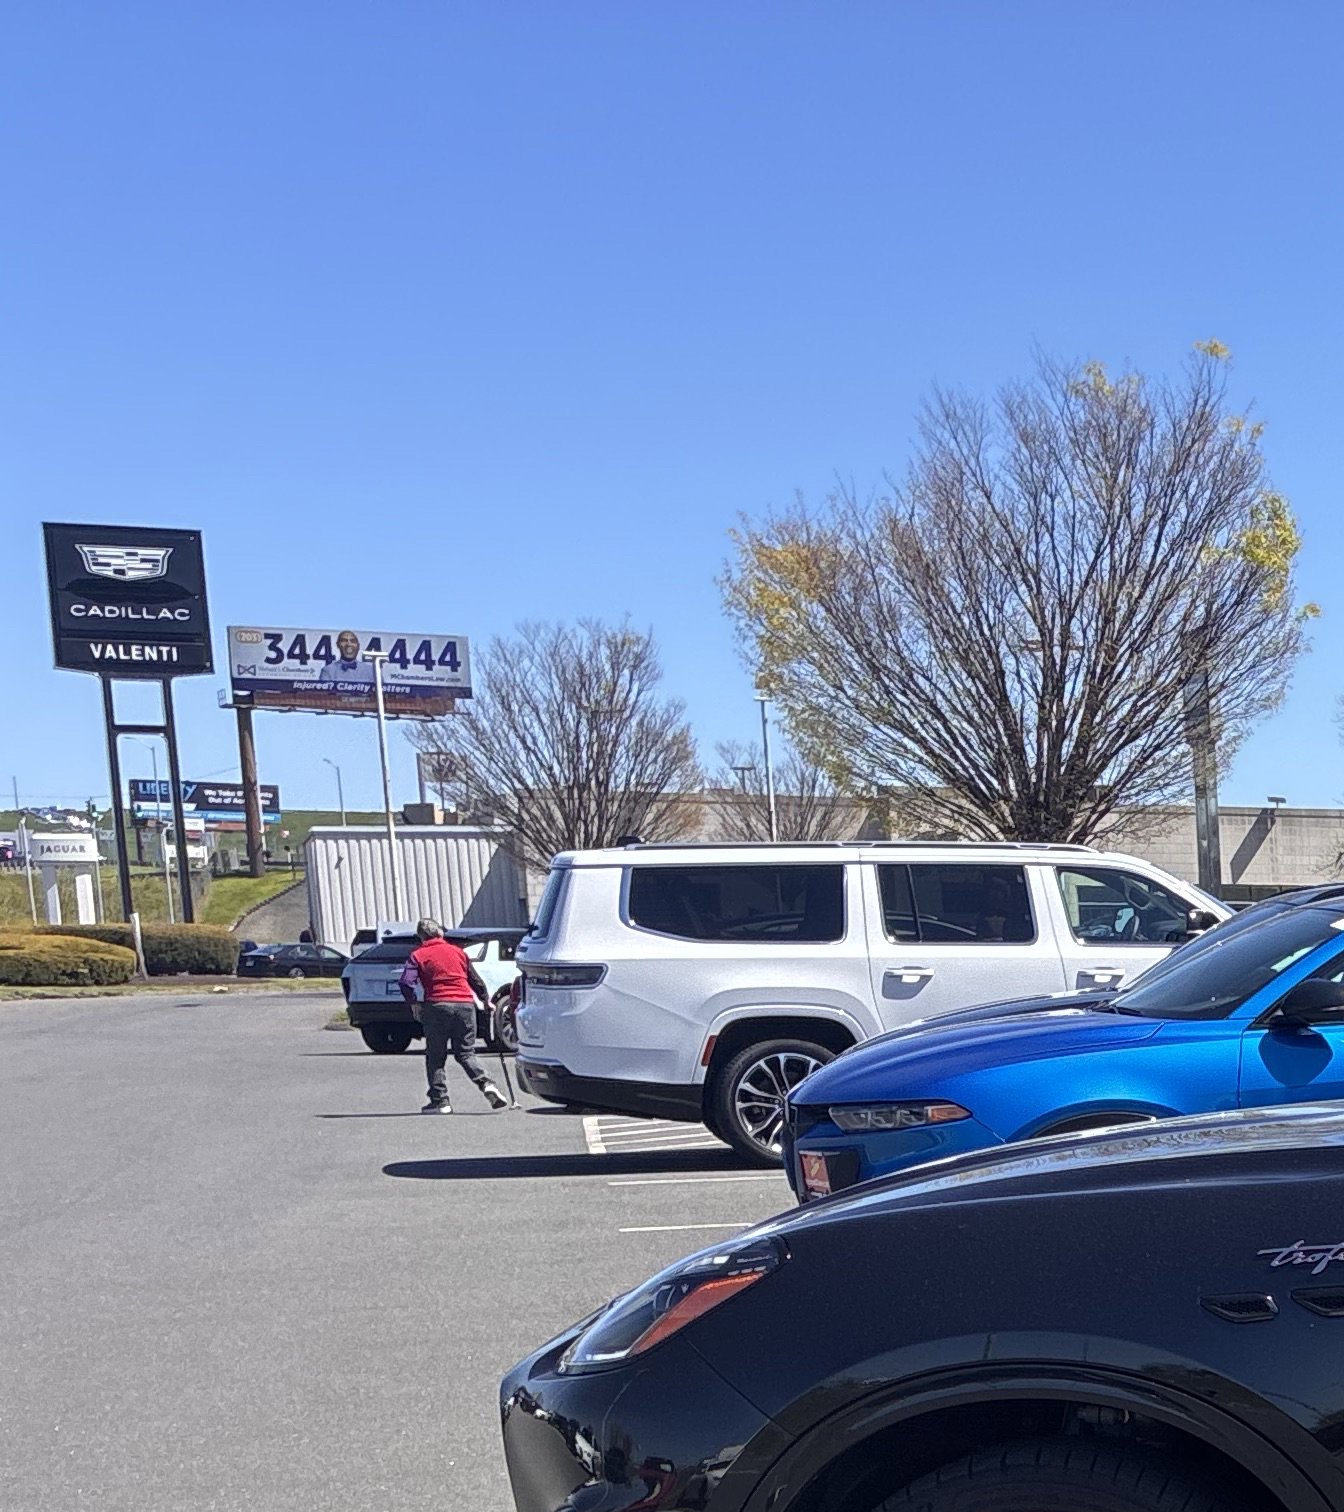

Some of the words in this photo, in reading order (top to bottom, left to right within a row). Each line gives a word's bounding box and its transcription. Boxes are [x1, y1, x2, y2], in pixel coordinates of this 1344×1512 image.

[70, 604, 191, 621] CADILLAC
[90, 642, 178, 662] VALENTI
[263, 632, 336, 666] 344
[293, 680, 334, 691] Injured?
[336, 682, 370, 693] Clarity
[372, 684, 411, 694] atters
[40, 844, 86, 856] JAGUAR
